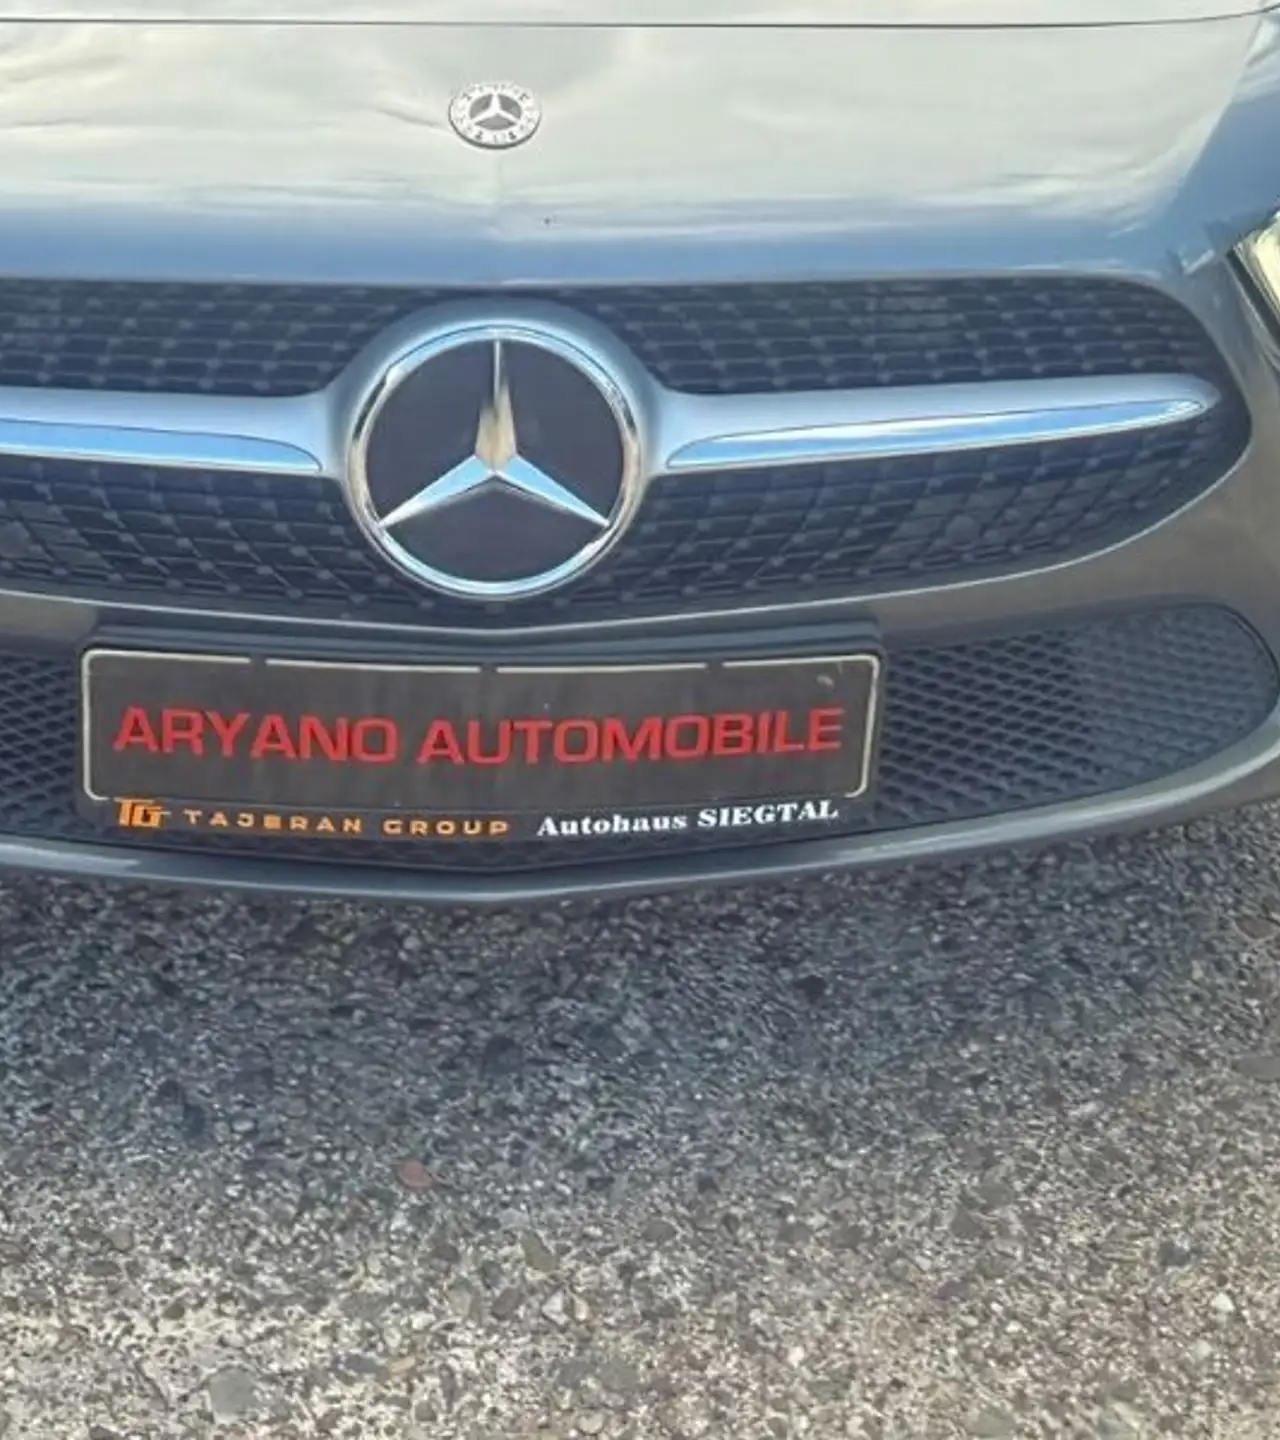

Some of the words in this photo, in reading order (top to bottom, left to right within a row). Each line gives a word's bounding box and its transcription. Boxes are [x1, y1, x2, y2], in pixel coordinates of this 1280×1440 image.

[112, 706, 397, 763] ARYANO
[415, 705, 847, 766] AUTOMOBILE
[184, 809, 363, 834] TAJERAN
[382, 816, 510, 837] GROUP
[535, 814, 688, 837] Autohaus
[696, 798, 840, 829] SIEGTAL
